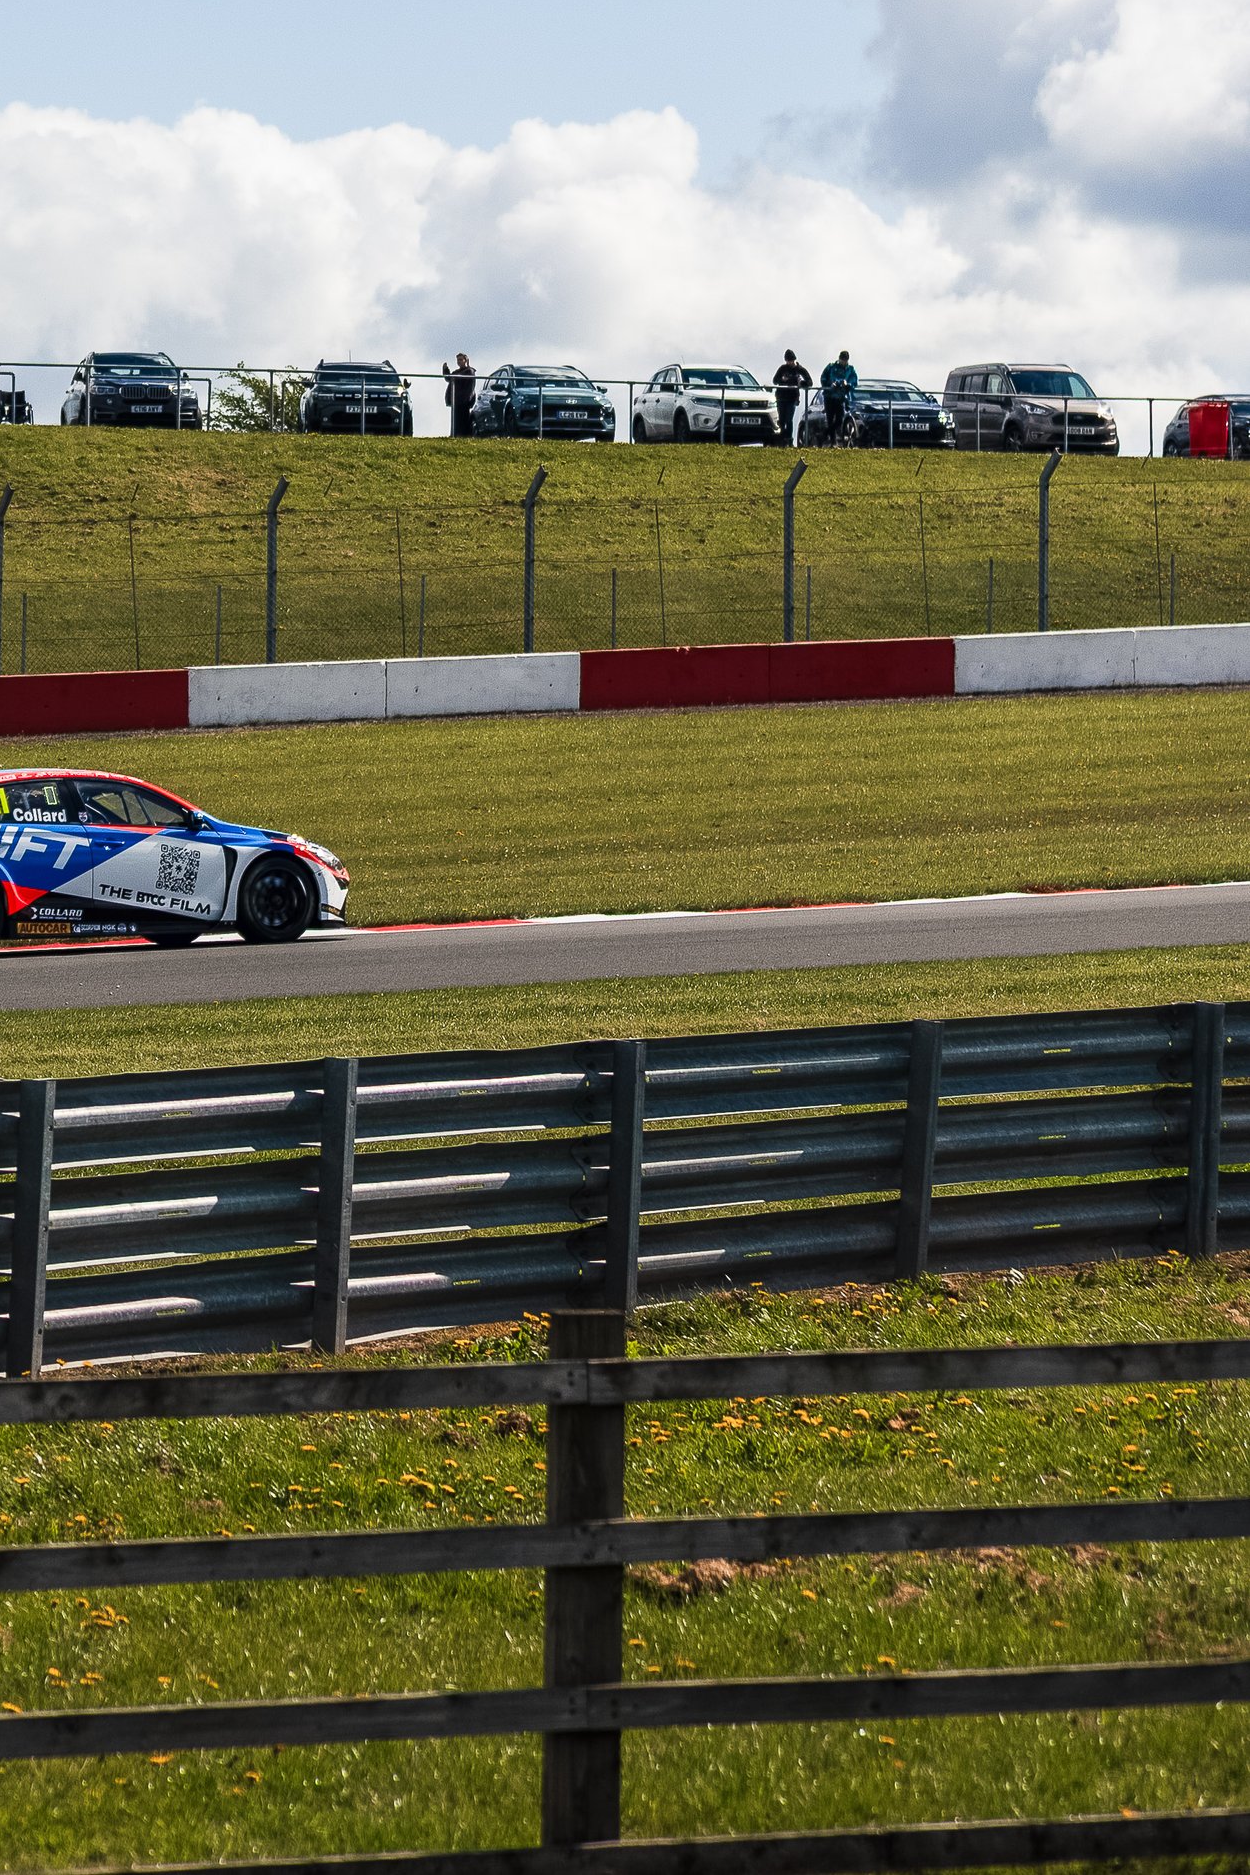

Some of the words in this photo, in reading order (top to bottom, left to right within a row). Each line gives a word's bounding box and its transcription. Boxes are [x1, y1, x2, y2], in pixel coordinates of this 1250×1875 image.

[13, 808, 67, 823] Collard
[99, 884, 133, 900] THE
[136, 891, 166, 906] BTCC
[170, 898, 211, 915] FILM
[39, 908, 83, 917] COLLARD
[19, 923, 68, 933] AUTOCAR
